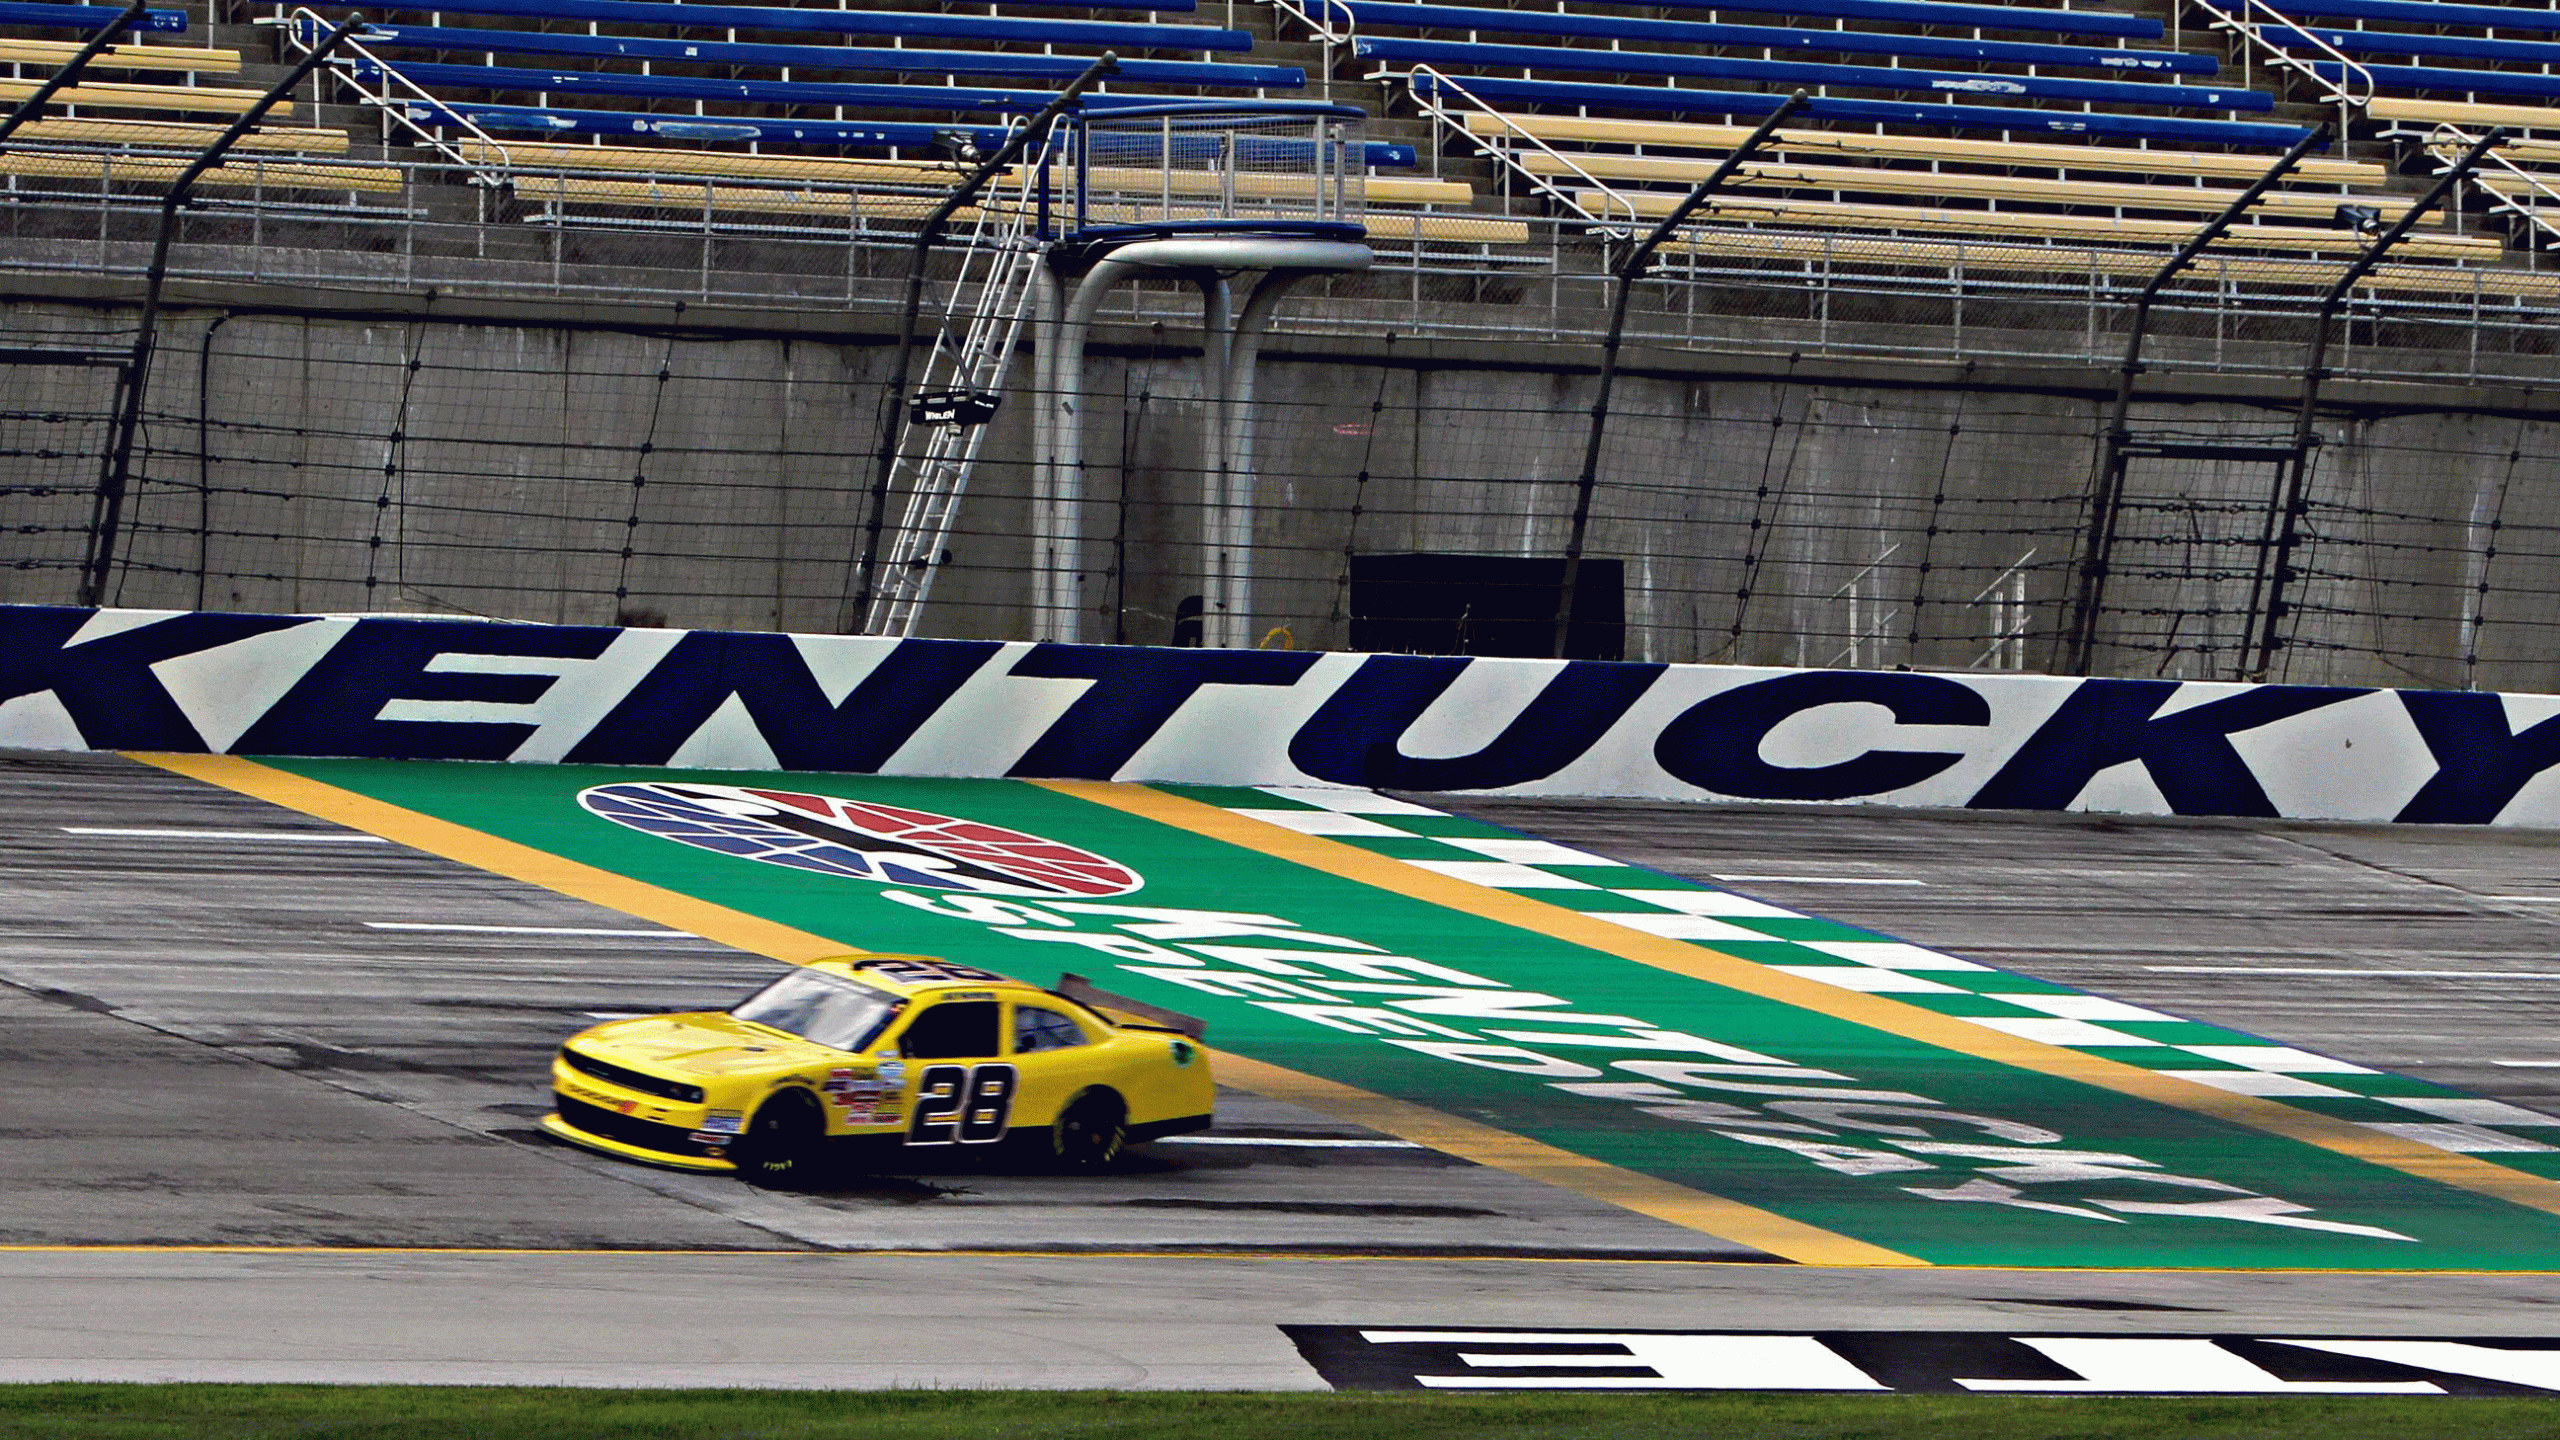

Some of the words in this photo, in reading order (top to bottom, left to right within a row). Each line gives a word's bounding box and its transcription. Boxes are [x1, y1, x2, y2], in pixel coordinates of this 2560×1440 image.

[0, 605, 2560, 825] KENTUCKY
[880, 889, 2128, 1224] SPEEDWAY
[902, 1062, 1020, 1146] 28
[1030, 900, 2420, 1243] KENTUCKY
